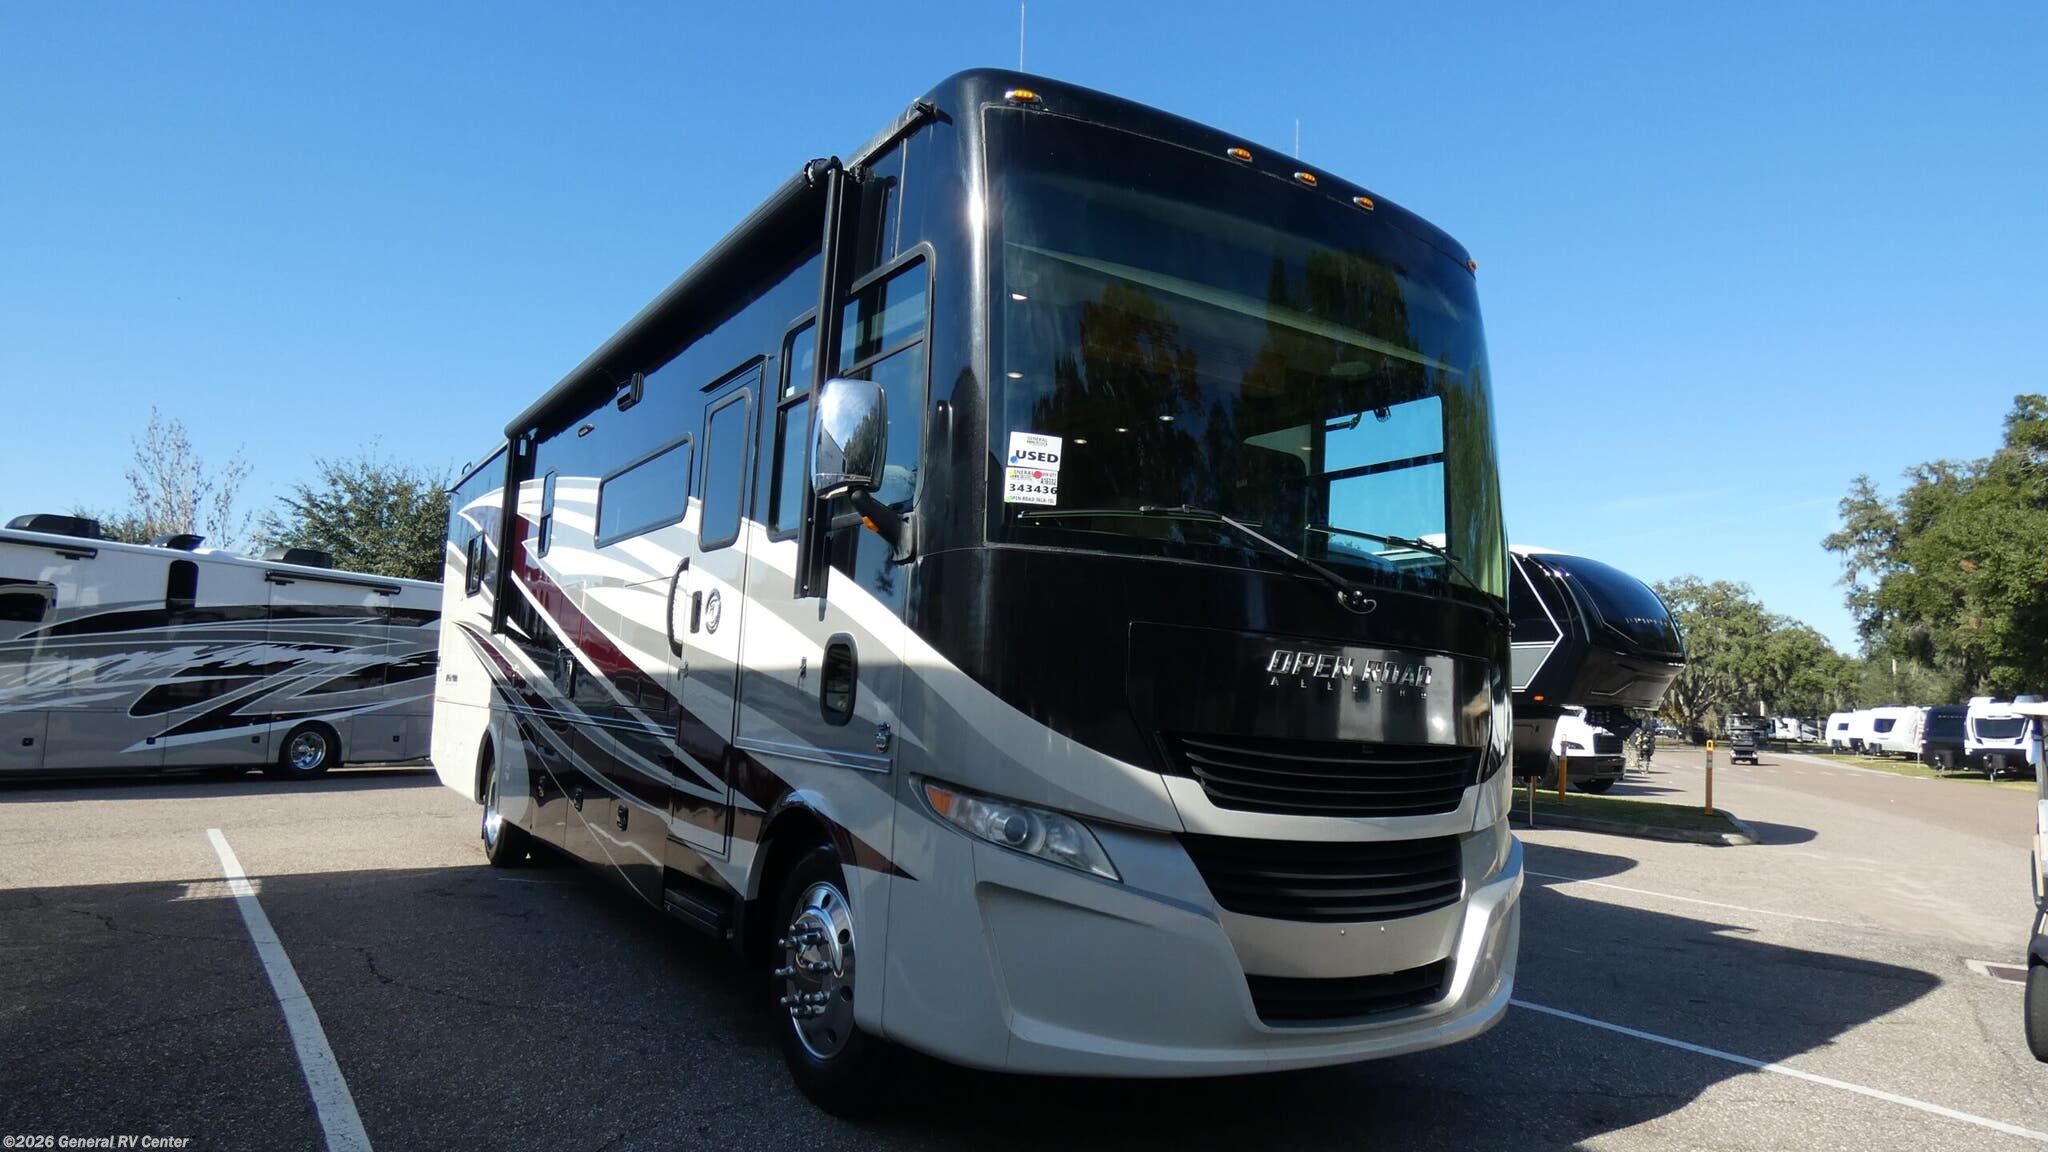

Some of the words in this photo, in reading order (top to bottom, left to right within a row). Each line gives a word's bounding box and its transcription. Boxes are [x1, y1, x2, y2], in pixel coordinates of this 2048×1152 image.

[1016, 450, 1059, 463] USED
[1009, 484, 1059, 494] 343436
[1267, 650, 1354, 679] OPEN
[1362, 660, 1432, 687] ROAD
